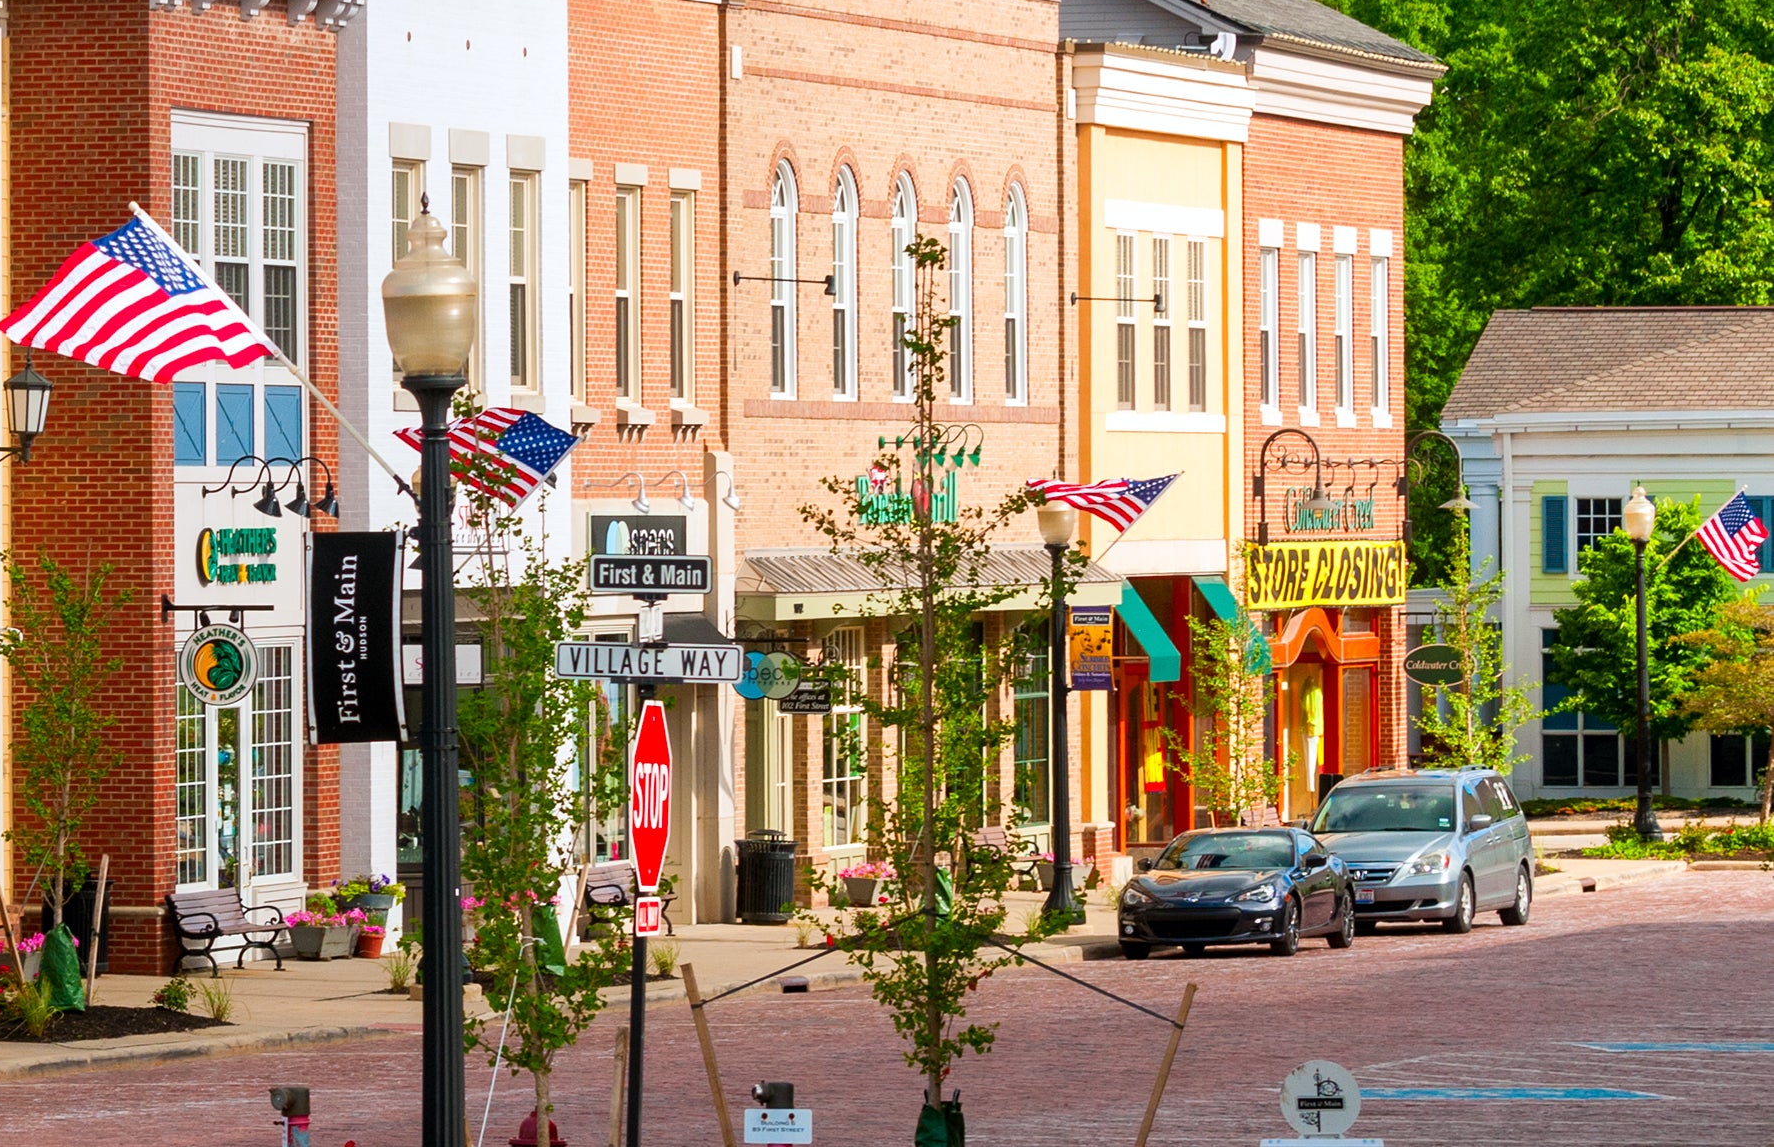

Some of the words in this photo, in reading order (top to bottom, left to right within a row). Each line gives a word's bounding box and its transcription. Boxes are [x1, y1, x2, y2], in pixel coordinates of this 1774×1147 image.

[333, 554, 359, 625] Main
[598, 563, 637, 585] First
[642, 563, 655, 585] &
[660, 563, 702, 586] Main
[1250, 547, 1310, 603] STORE
[1311, 546, 1403, 601] CLOSING!
[192, 628, 246, 647] HEATHER'S
[335, 630, 356, 654] &
[359, 616, 368, 660] HUDSON
[569, 646, 664, 675] VILLAGE
[681, 650, 728, 677] WAY
[1406, 660, 1447, 670] Coldwater
[190, 681, 209, 699] HEAT
[219, 683, 246, 701] FLAVOR
[336, 659, 362, 724] First
[633, 761, 669, 830] STOP
